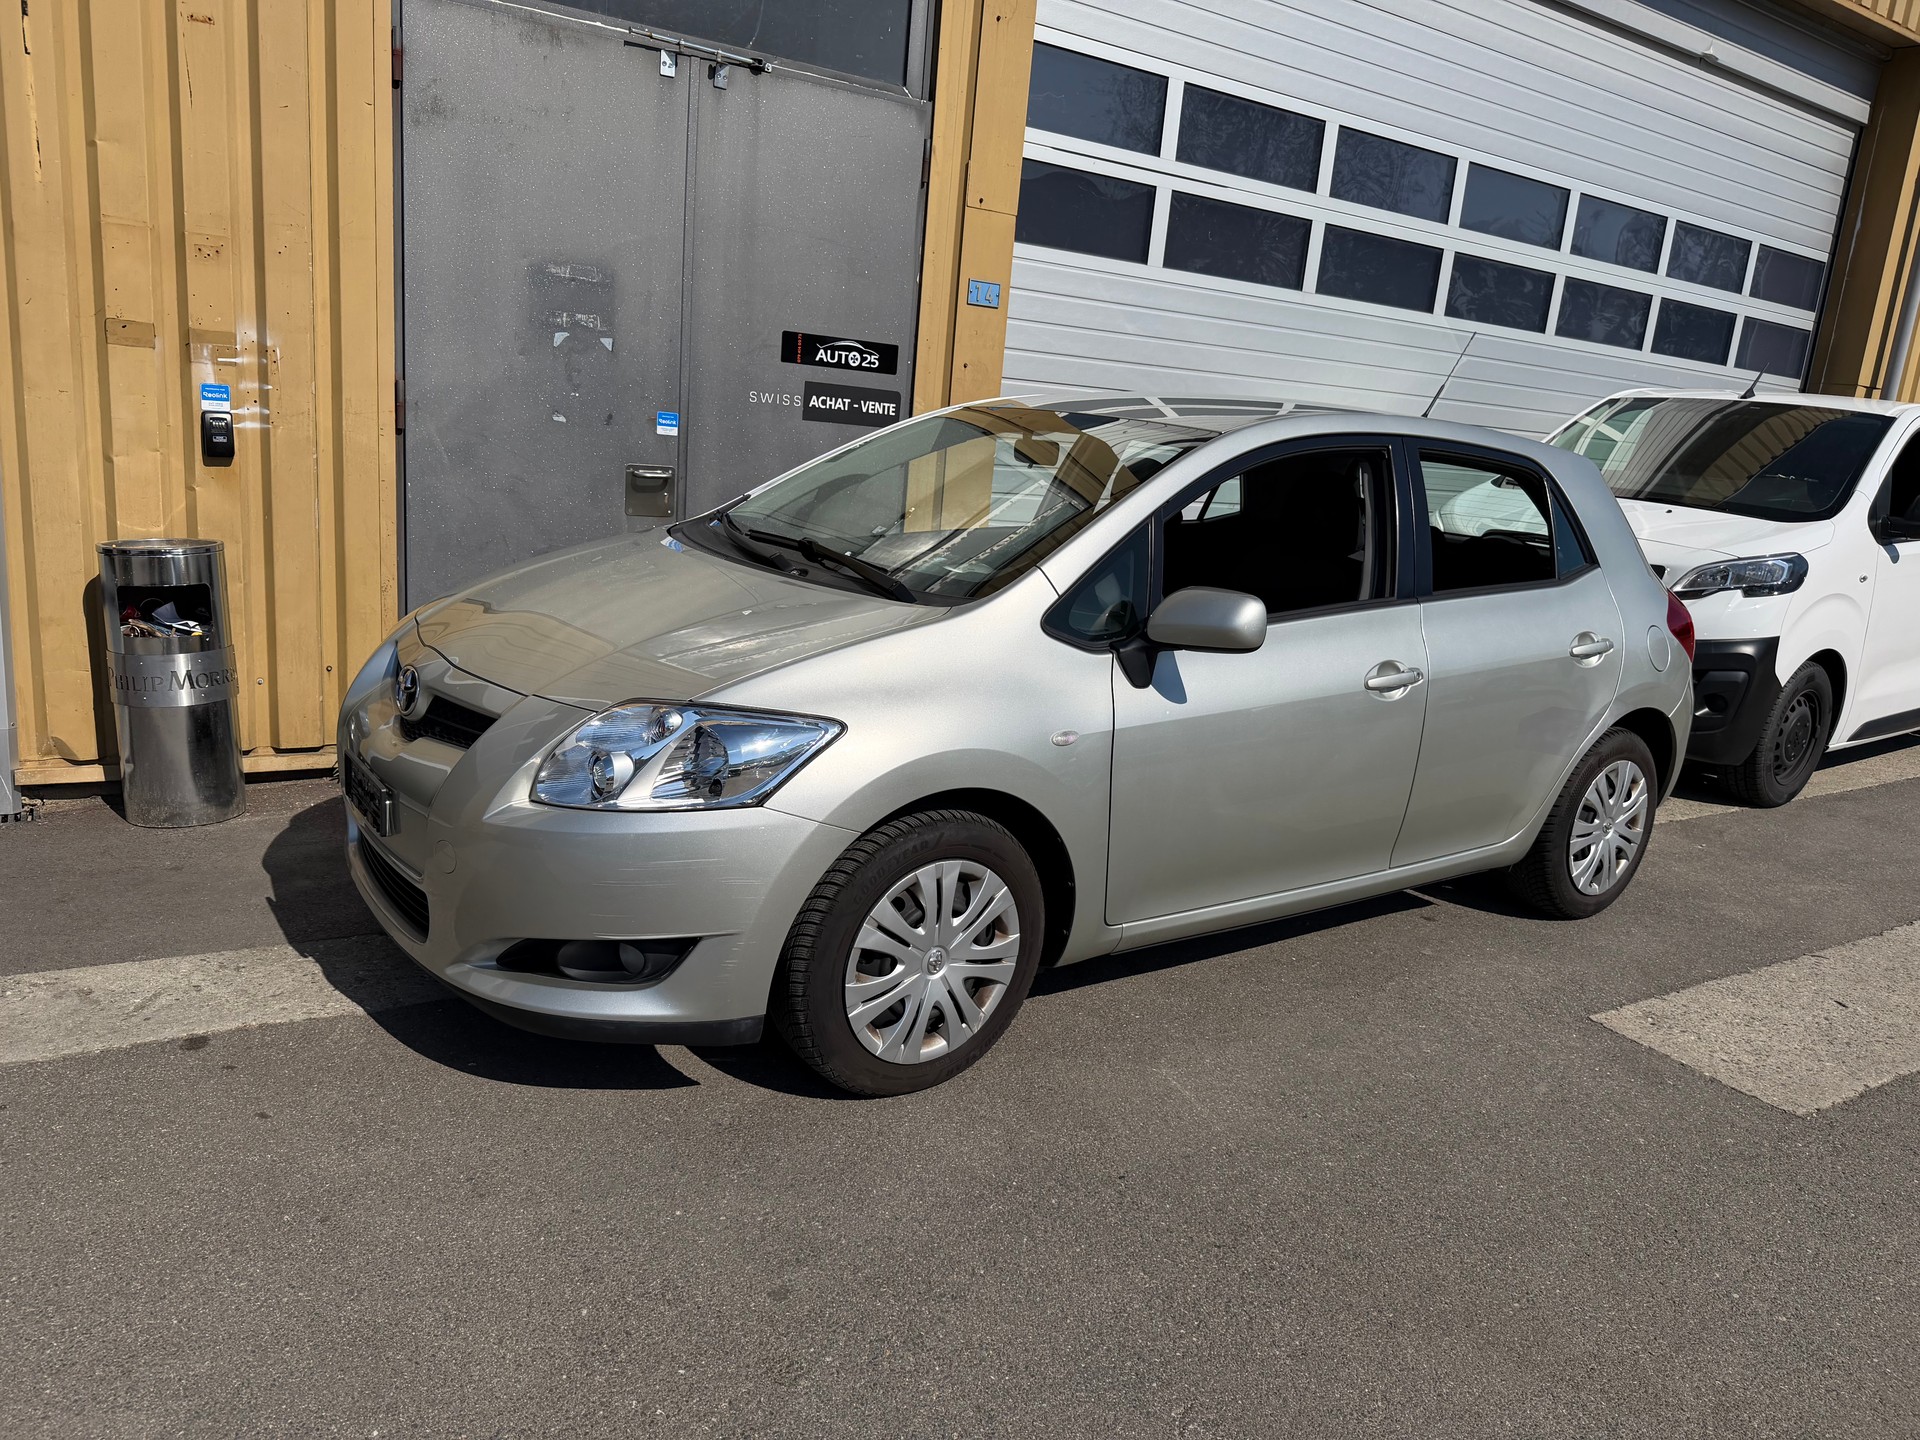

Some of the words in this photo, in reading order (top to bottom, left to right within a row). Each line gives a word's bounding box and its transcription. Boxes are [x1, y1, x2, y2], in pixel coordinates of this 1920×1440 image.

[975, 284, 993, 304] 14
[862, 354, 879, 367] 25
[749, 391, 802, 407] SWISS
[808, 395, 851, 411] ACHAT
[861, 401, 896, 416] VENTE
